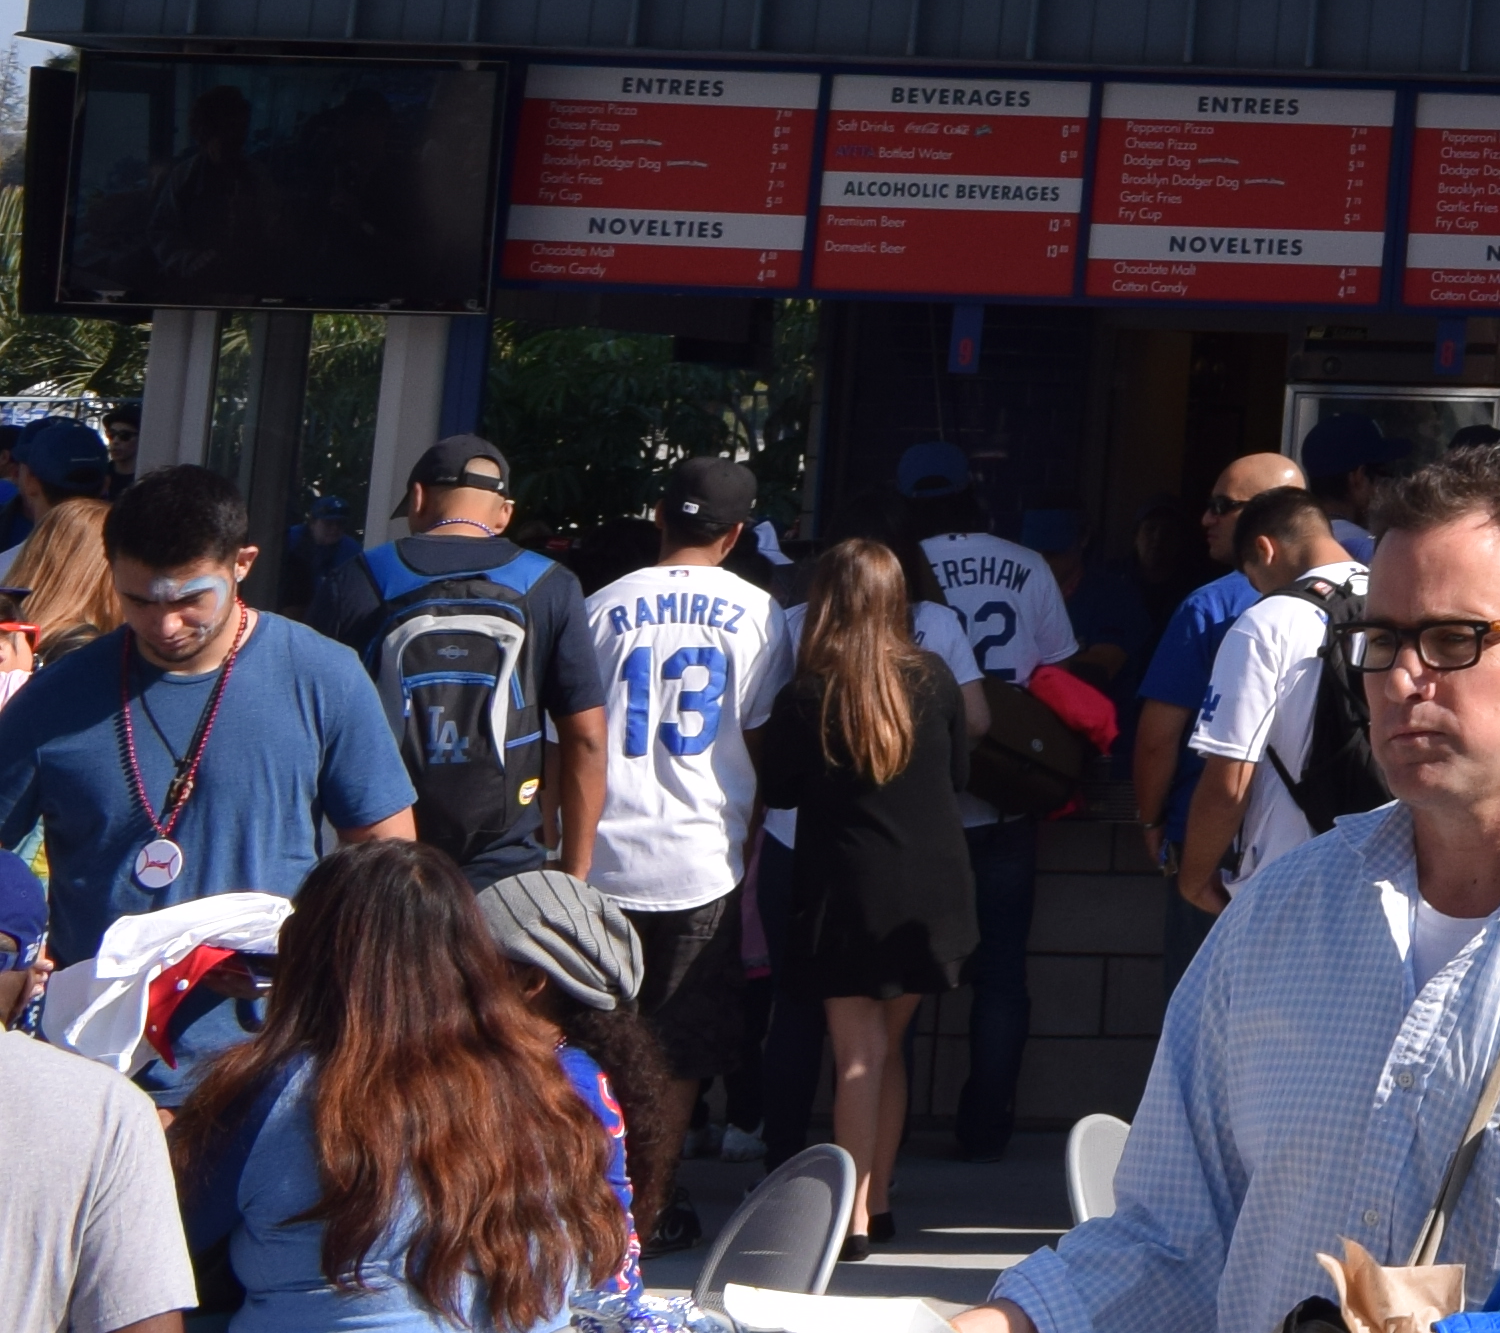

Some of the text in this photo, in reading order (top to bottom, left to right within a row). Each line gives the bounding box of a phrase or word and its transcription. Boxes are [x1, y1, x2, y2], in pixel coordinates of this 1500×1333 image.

[620, 76, 724, 97] ENTREES
[891, 86, 1030, 107] BEVERAGES
[1197, 95, 1299, 115] ENTREES
[1126, 120, 1214, 134] Pepperoni Pizza
[1124, 136, 1197, 150] Cheese Pizza
[878, 146, 915, 159] Bottled
[918, 148, 952, 160] Water
[1122, 153, 1164, 169] Dodger
[1167, 154, 1191, 170] Dog
[843, 180, 1060, 201] ALCOHOLIC BEVERAGES
[1121, 172, 1239, 190] Brooklyn Dodger Dog
[1119, 190, 1181, 204] Garlic Fries
[826, 213, 905, 227] Premium Beer
[1117, 206, 1162, 222] Fry Cup
[587, 216, 723, 239] NOVELTIES
[824, 239, 905, 253] Domestic Beer
[1168, 235, 1303, 256] NOVELTIES
[1113, 260, 1196, 275] Chocolate Malt
[1111, 279, 1187, 295] Cotton Candy
[957, 337, 975, 367] 9
[930, 556, 1032, 593] ERSHAW
[609, 593, 746, 634] RAMIREZ
[622, 646, 729, 756] 13
[426, 706, 471, 764] LA
